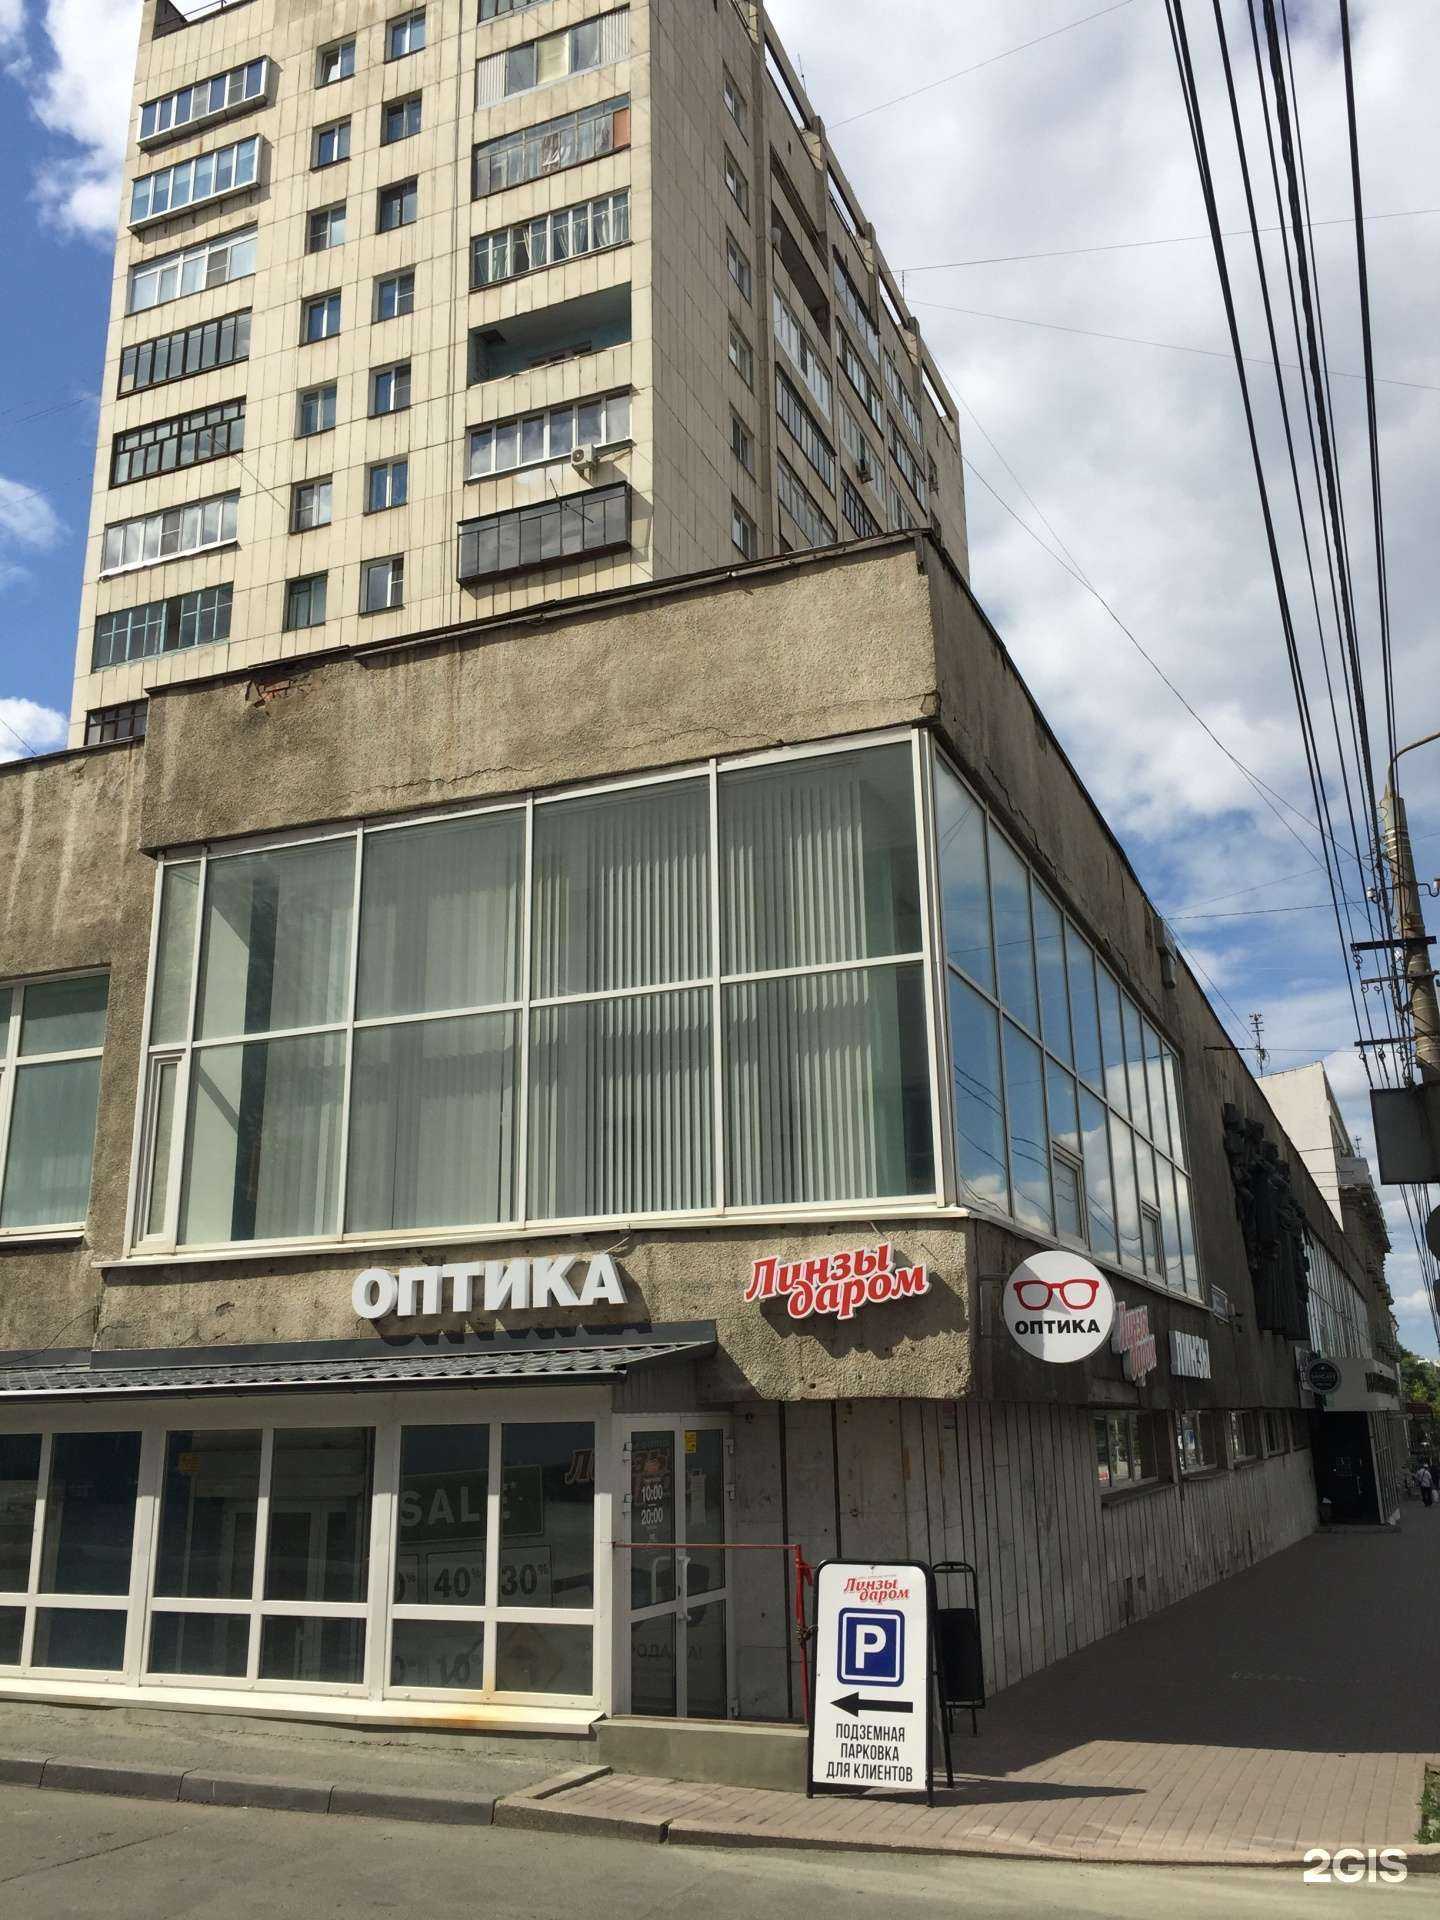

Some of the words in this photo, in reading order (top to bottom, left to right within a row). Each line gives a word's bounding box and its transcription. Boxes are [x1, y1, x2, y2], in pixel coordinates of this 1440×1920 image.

[745, 1242, 892, 1300] Линзы
[352, 1254, 627, 1320] ОПТИКА
[788, 1264, 929, 1320] даром
[1015, 1318, 1101, 1336] ОПТИКА
[641, 1484, 664, 1502] 10:00
[641, 1507, 664, 1525] 20:00
[843, 1577, 898, 1593] Линзы
[859, 1588, 910, 1604] даром
[855, 1624, 887, 1669] P
[835, 1723, 905, 1743] ПОДЗЕМНАЯ
[840, 1742, 900, 1762] ПАРКОВКА
[826, 1762, 850, 1780] ДЛЯ
[853, 1763, 913, 1783] КЛИЕНТОВ
